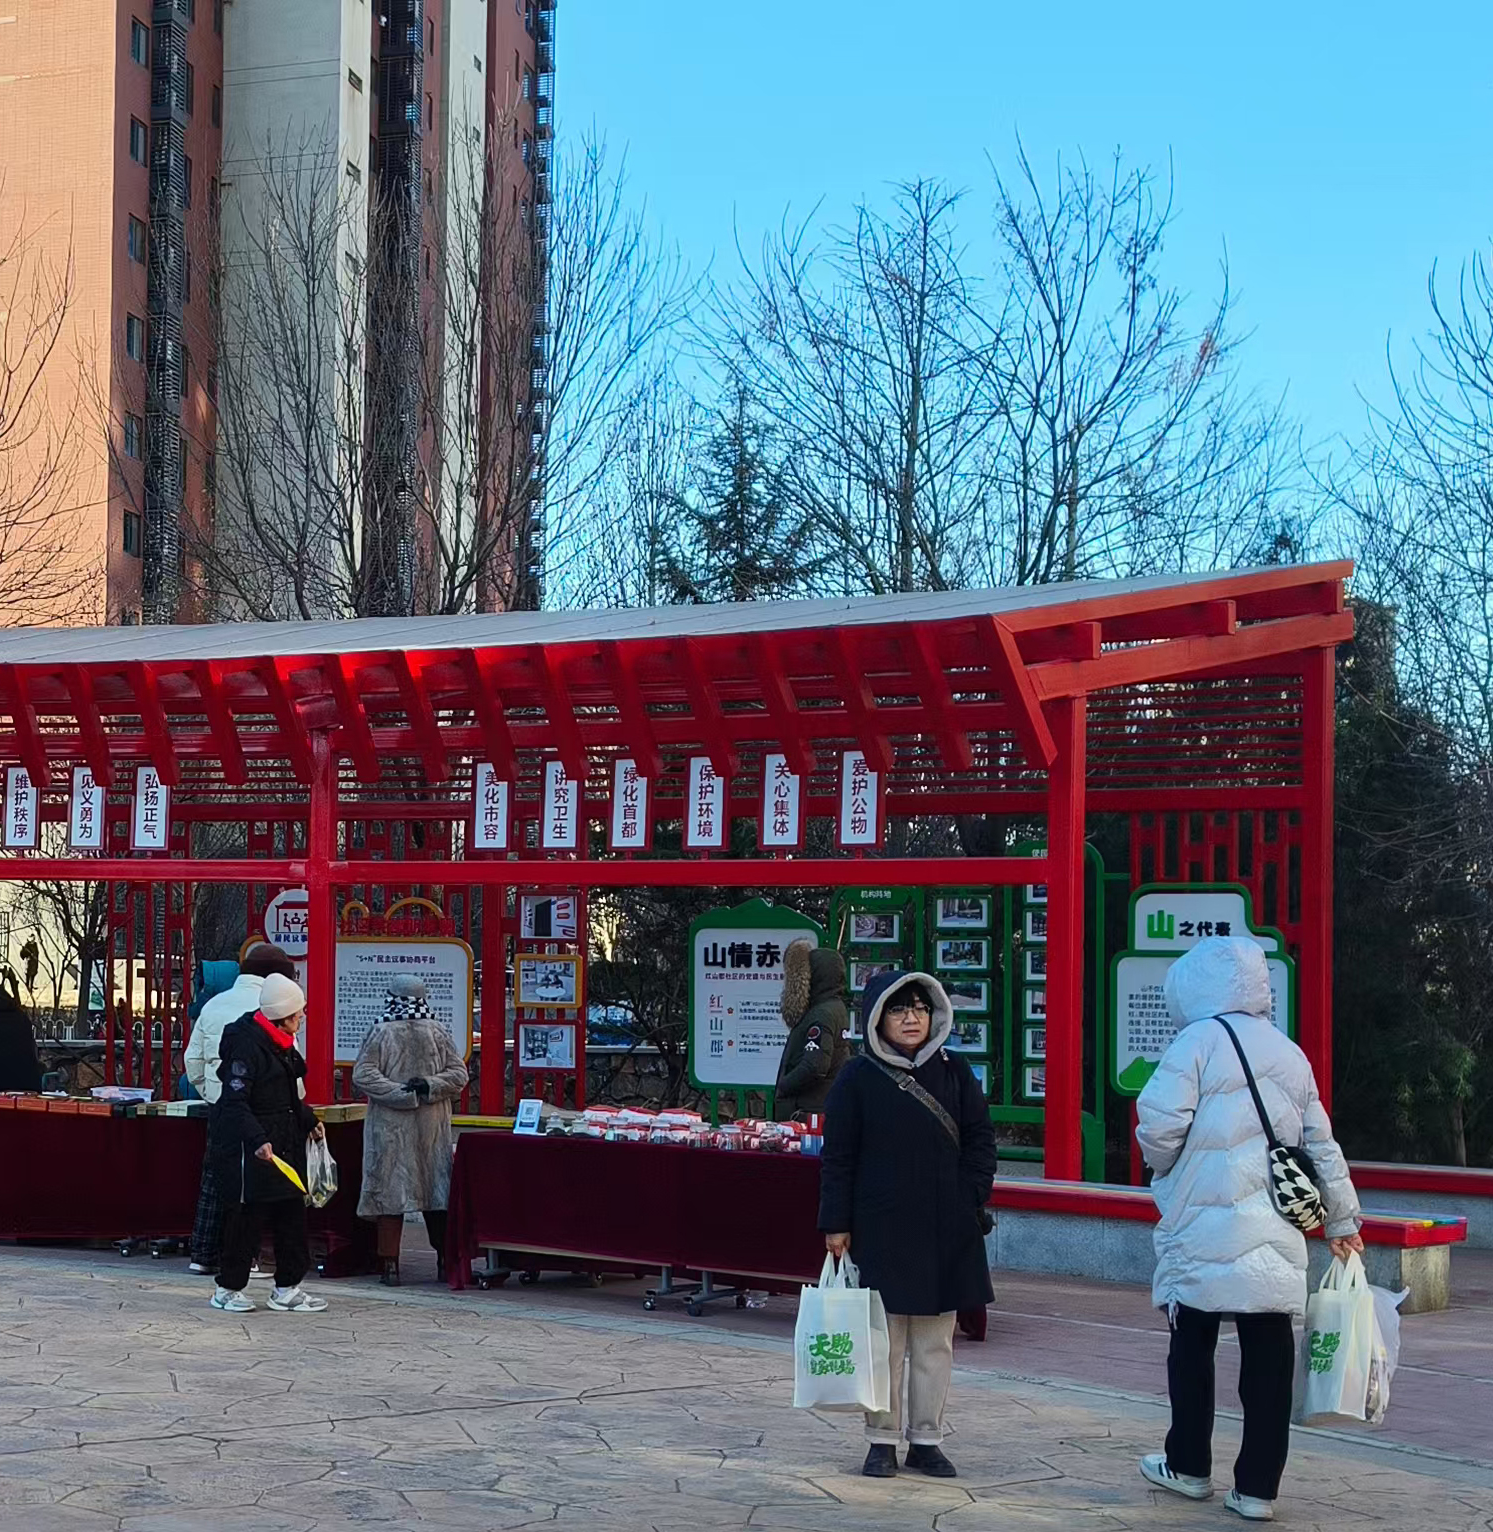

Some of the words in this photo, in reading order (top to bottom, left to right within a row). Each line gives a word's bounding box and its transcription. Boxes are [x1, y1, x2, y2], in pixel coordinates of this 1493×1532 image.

[13, 774, 29, 839] 维护秩序
[79, 774, 95, 839] 见义勇为
[143, 774, 159, 839] 弘扬正气
[483, 770, 500, 840] 美化市容
[552, 769, 569, 839] 讲究卫生
[621, 767, 639, 838] 绿化首都
[697, 764, 716, 837] 保护环境
[772, 762, 791, 836] 关心集体
[851, 758, 869, 835] 爱护公物
[704, 942, 785, 969] 山情赤
